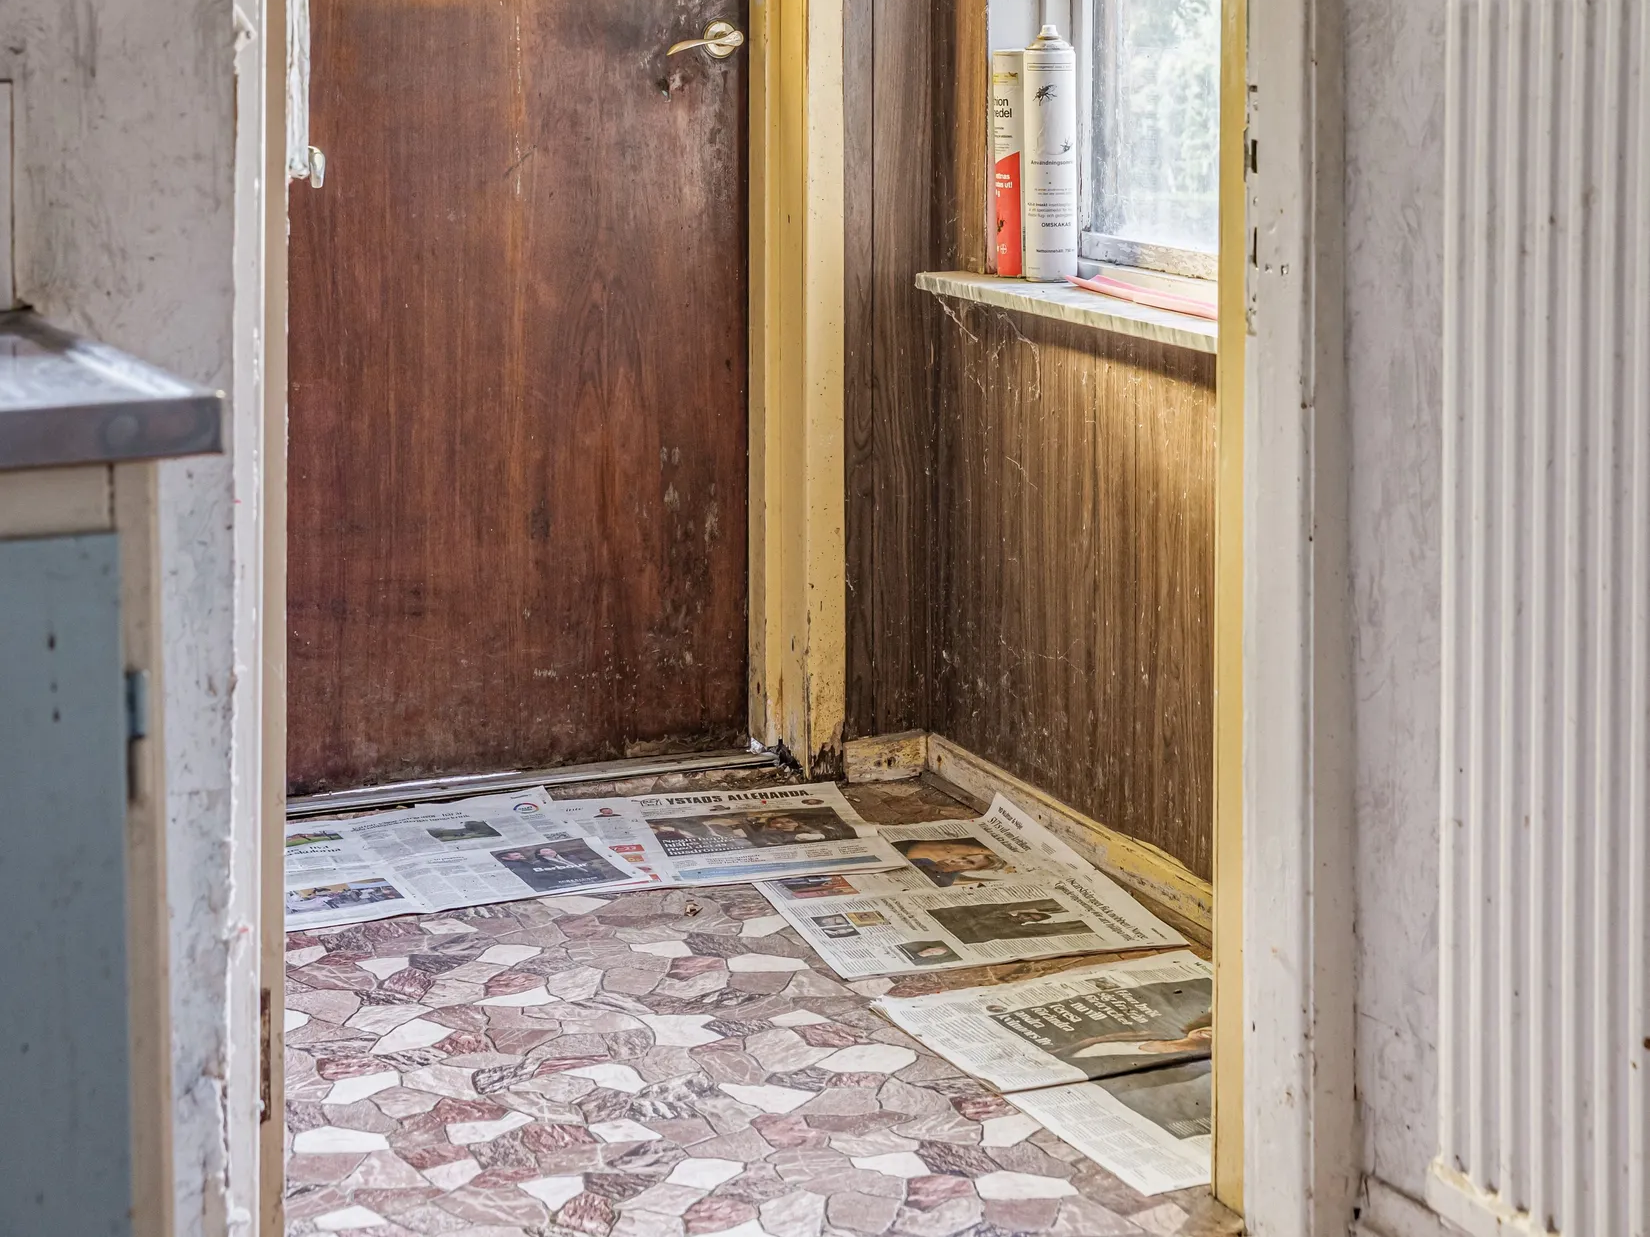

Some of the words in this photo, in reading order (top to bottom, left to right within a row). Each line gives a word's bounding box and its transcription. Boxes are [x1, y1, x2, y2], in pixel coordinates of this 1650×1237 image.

[666, 795, 723, 805] YSTADS
[533, 863, 587, 872] Barbour
[1014, 1011, 1045, 1029] andra
[1050, 1003, 1082, 1023] Teresa
